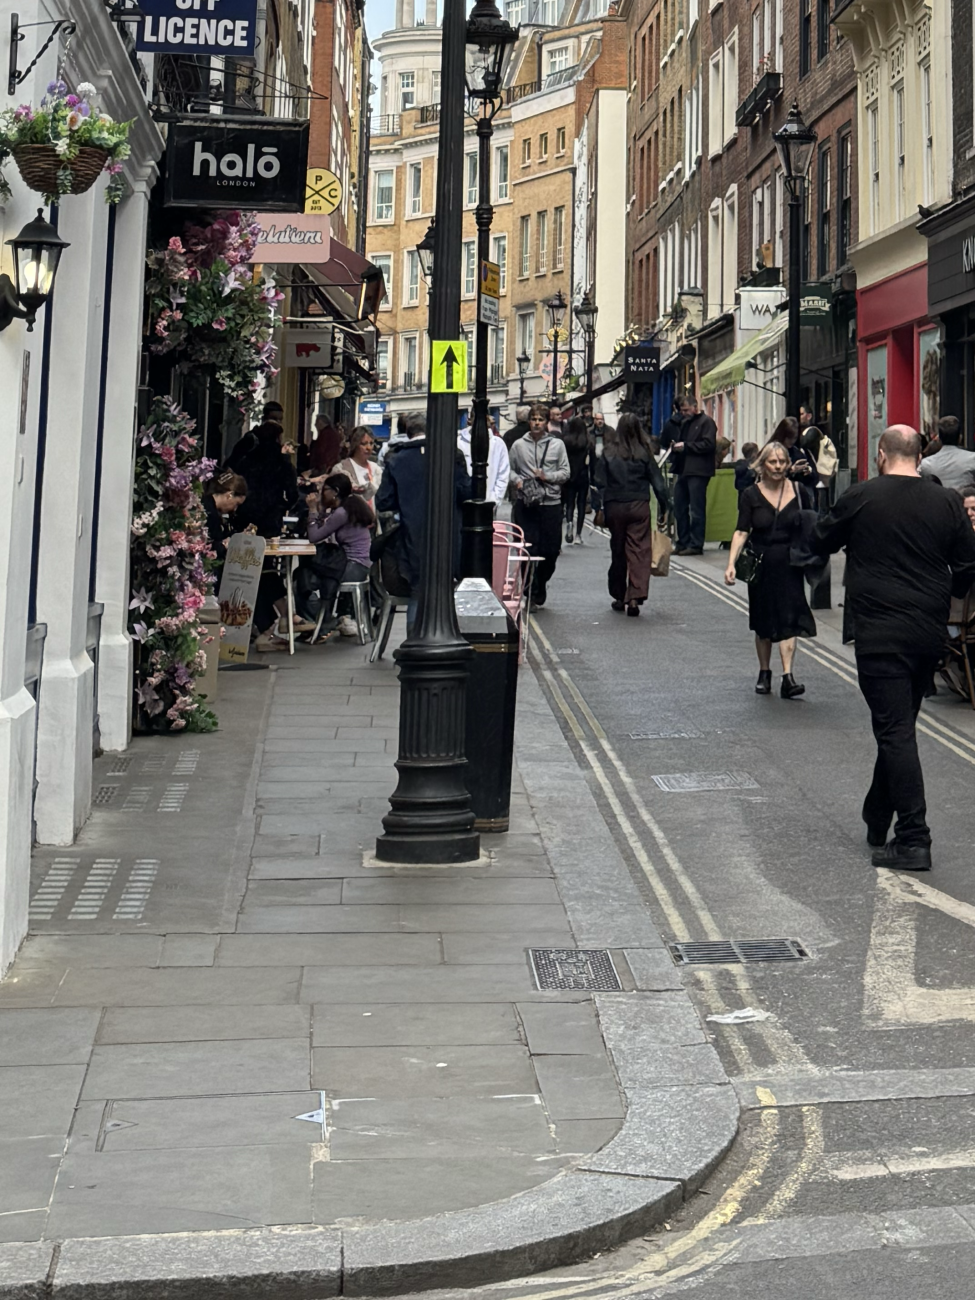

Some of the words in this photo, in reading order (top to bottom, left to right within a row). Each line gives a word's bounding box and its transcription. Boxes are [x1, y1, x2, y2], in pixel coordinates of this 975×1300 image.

[143, 15, 249, 47] LICENCE
[216, 179, 256, 187] LONDON
[314, 174, 323, 185] P
[328, 188, 338, 199] C
[627, 356, 657, 364] SANTA
[630, 364, 654, 372] NATA
